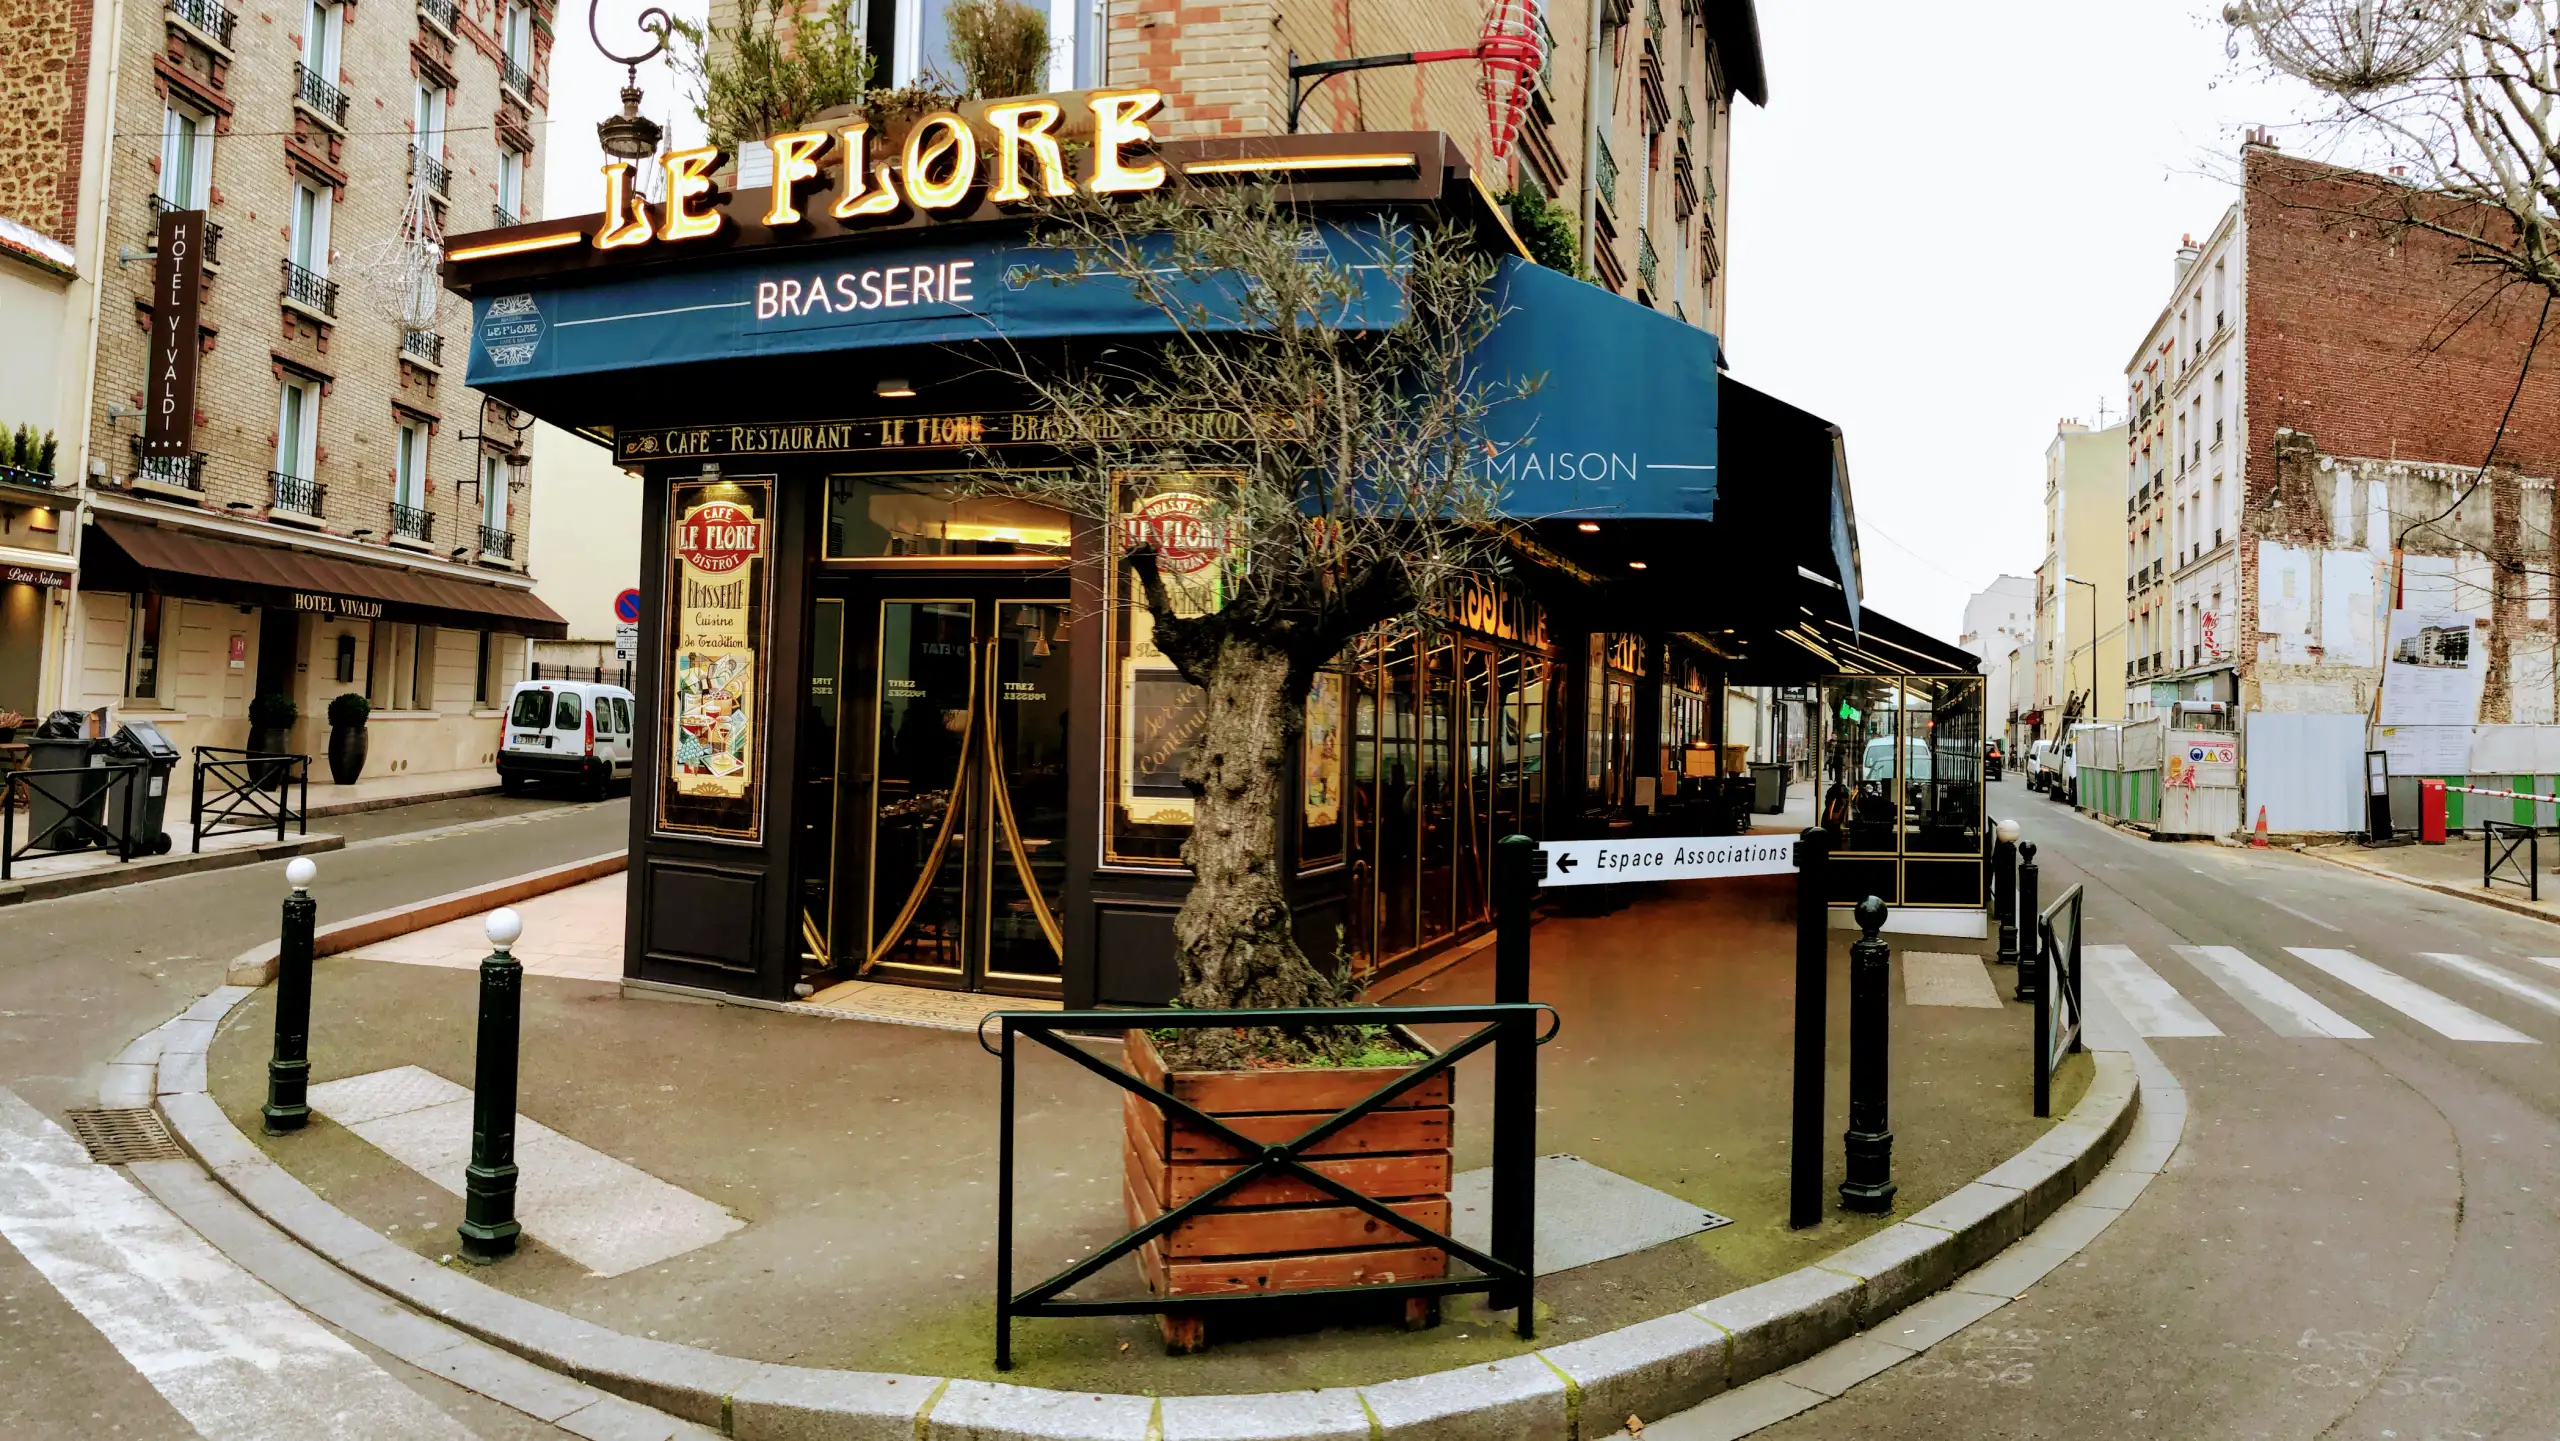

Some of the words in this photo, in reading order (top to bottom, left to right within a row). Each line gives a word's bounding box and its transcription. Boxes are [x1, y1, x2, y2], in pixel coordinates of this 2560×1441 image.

[593, 145, 723, 250] LE
[762, 89, 1168, 226] FLORE
[171, 224, 186, 306] HOTEL
[757, 261, 975, 320] BRASSERIE
[487, 327, 501, 337] LE
[502, 324, 538, 335] FLORE
[162, 315, 181, 431] VIVALDI
[731, 425, 852, 451] RESTAURANT
[881, 419, 906, 446] LE
[917, 416, 985, 445] FLORE
[1486, 452, 1637, 482] MAISON
[703, 507, 735, 521] CAFÉ
[679, 525, 700, 550] LE
[705, 524, 756, 551] FLORE
[691, 552, 740, 571] BISTROT
[7, 567, 34, 583] Petit
[35, 571, 63, 586] Salon
[294, 593, 336, 613] HOTEL
[340, 598, 383, 618] VIVALDI
[695, 611, 734, 627] Cuisine
[684, 634, 696, 648] de
[697, 634, 744, 649] Tradition
[1597, 849, 1664, 872] Espace
[1673, 843, 1788, 866] Associations
